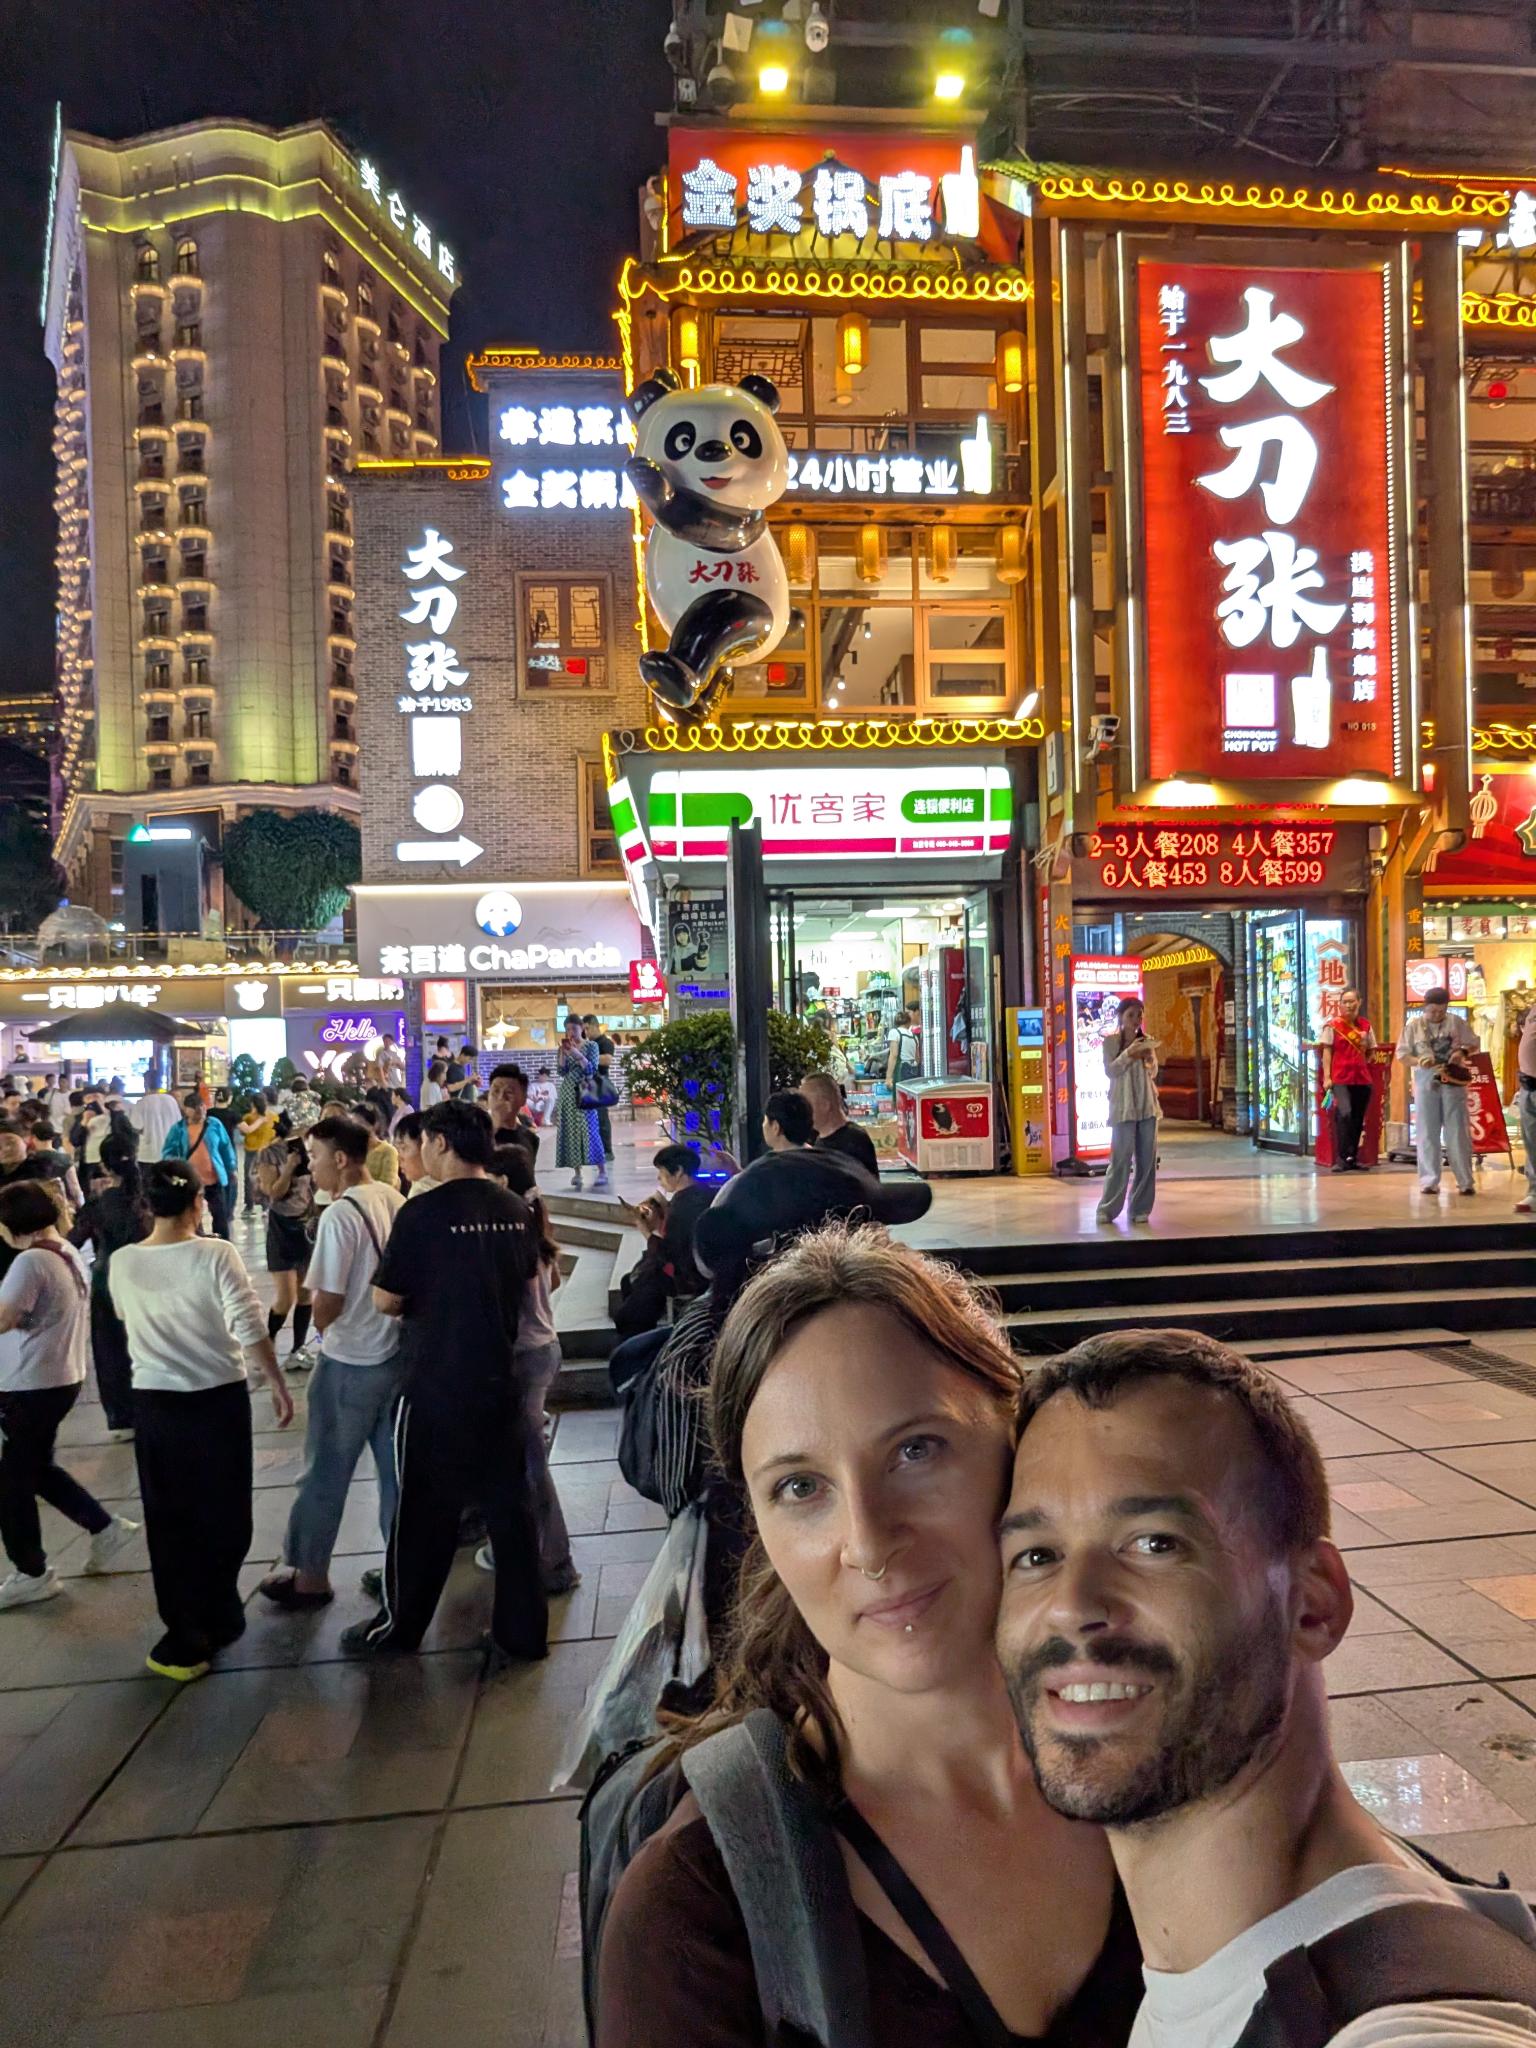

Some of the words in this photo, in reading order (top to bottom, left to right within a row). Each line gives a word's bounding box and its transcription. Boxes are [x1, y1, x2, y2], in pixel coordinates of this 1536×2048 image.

[681, 158, 933, 242] 金奖锅底
[1160, 284, 1191, 434] 始于一九八三
[787, 456, 959, 497] 24小时营业
[1198, 287, 1347, 648] 大刀张
[689, 559, 761, 585] 大刀张
[401, 530, 470, 693] 大刀张
[1224, 740, 1249, 752] HOT
[1251, 740, 1277, 752] POT
[769, 793, 886, 825] 优客家
[913, 797, 975, 815] 连锁便利店
[1090, 830, 1219, 858] 2-3人餐208
[1231, 830, 1334, 858] 4人餐357
[1102, 860, 1208, 888] 6人餐453
[1219, 859, 1323, 886] 8人餐599
[380, 943, 466, 975] 茶百道
[469, 941, 621, 972] ChaPanda
[323, 1018, 378, 1041] Hello
